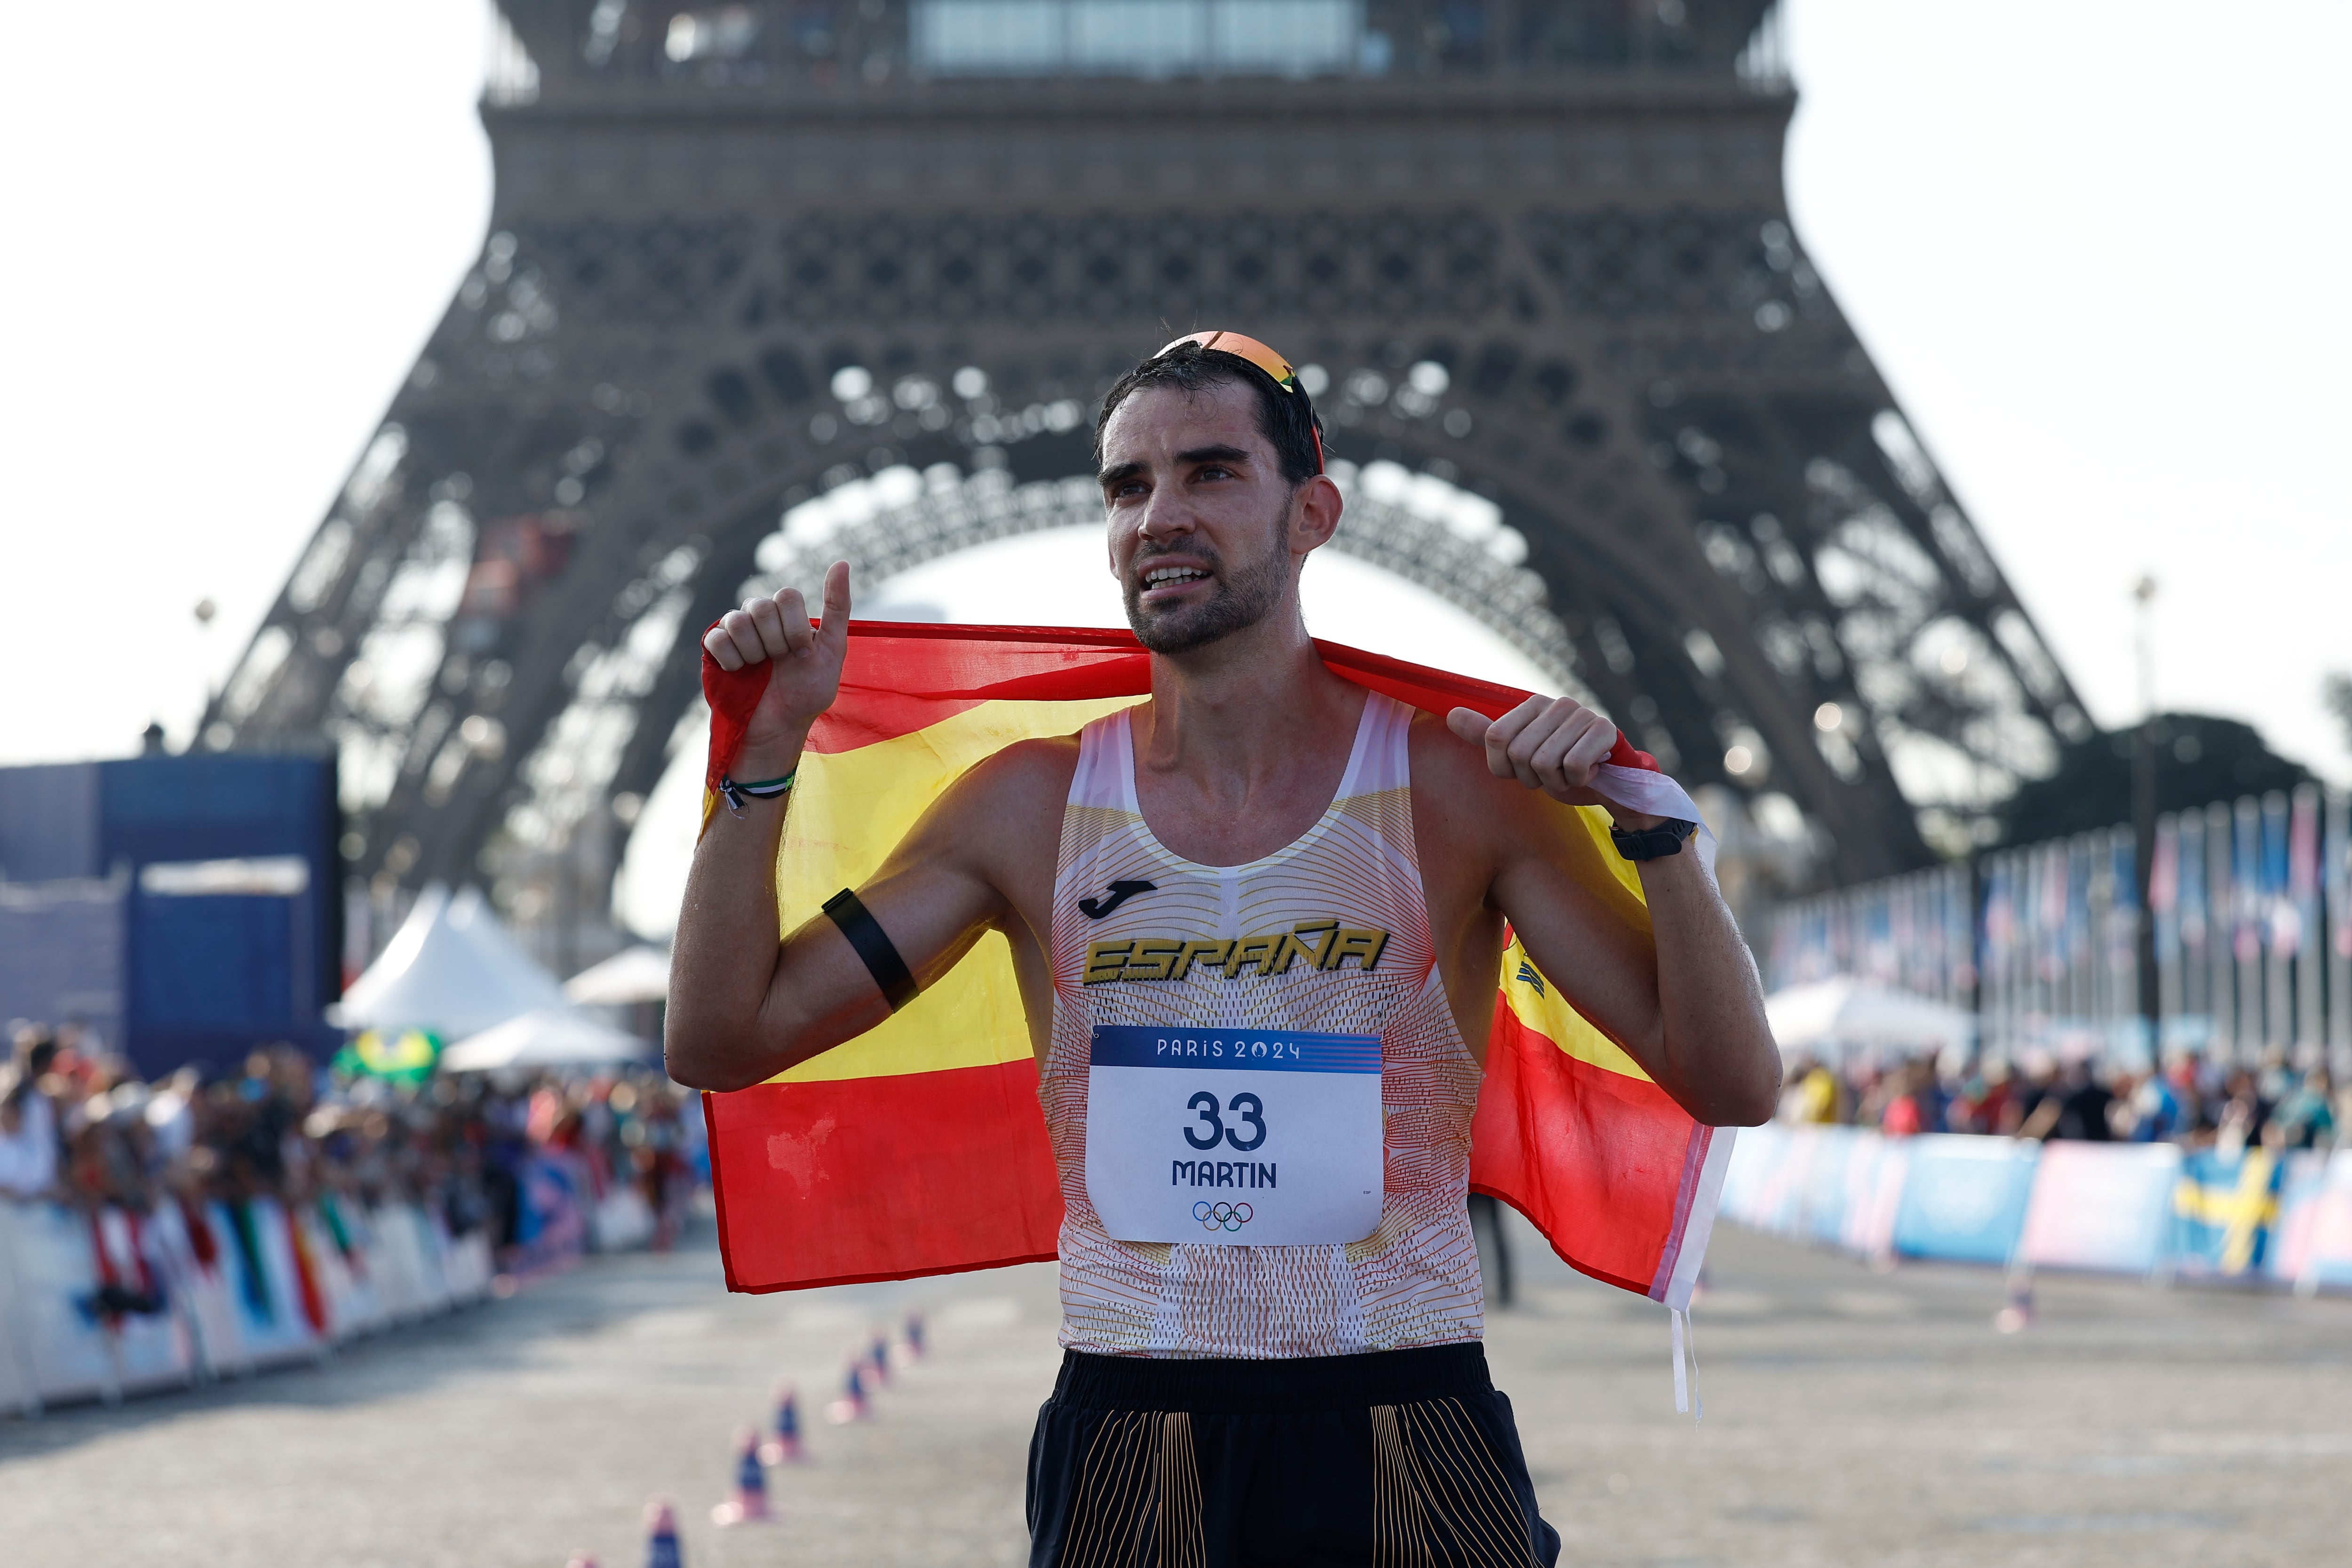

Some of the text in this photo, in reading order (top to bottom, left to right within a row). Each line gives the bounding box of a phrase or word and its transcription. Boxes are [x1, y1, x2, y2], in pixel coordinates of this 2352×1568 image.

[1084, 920, 1390, 986] ESPAÑA
[1234, 1041, 1300, 1059] 2024
[1184, 1091, 1266, 1151] 33
[1172, 1160, 1276, 1188] MARTIN
